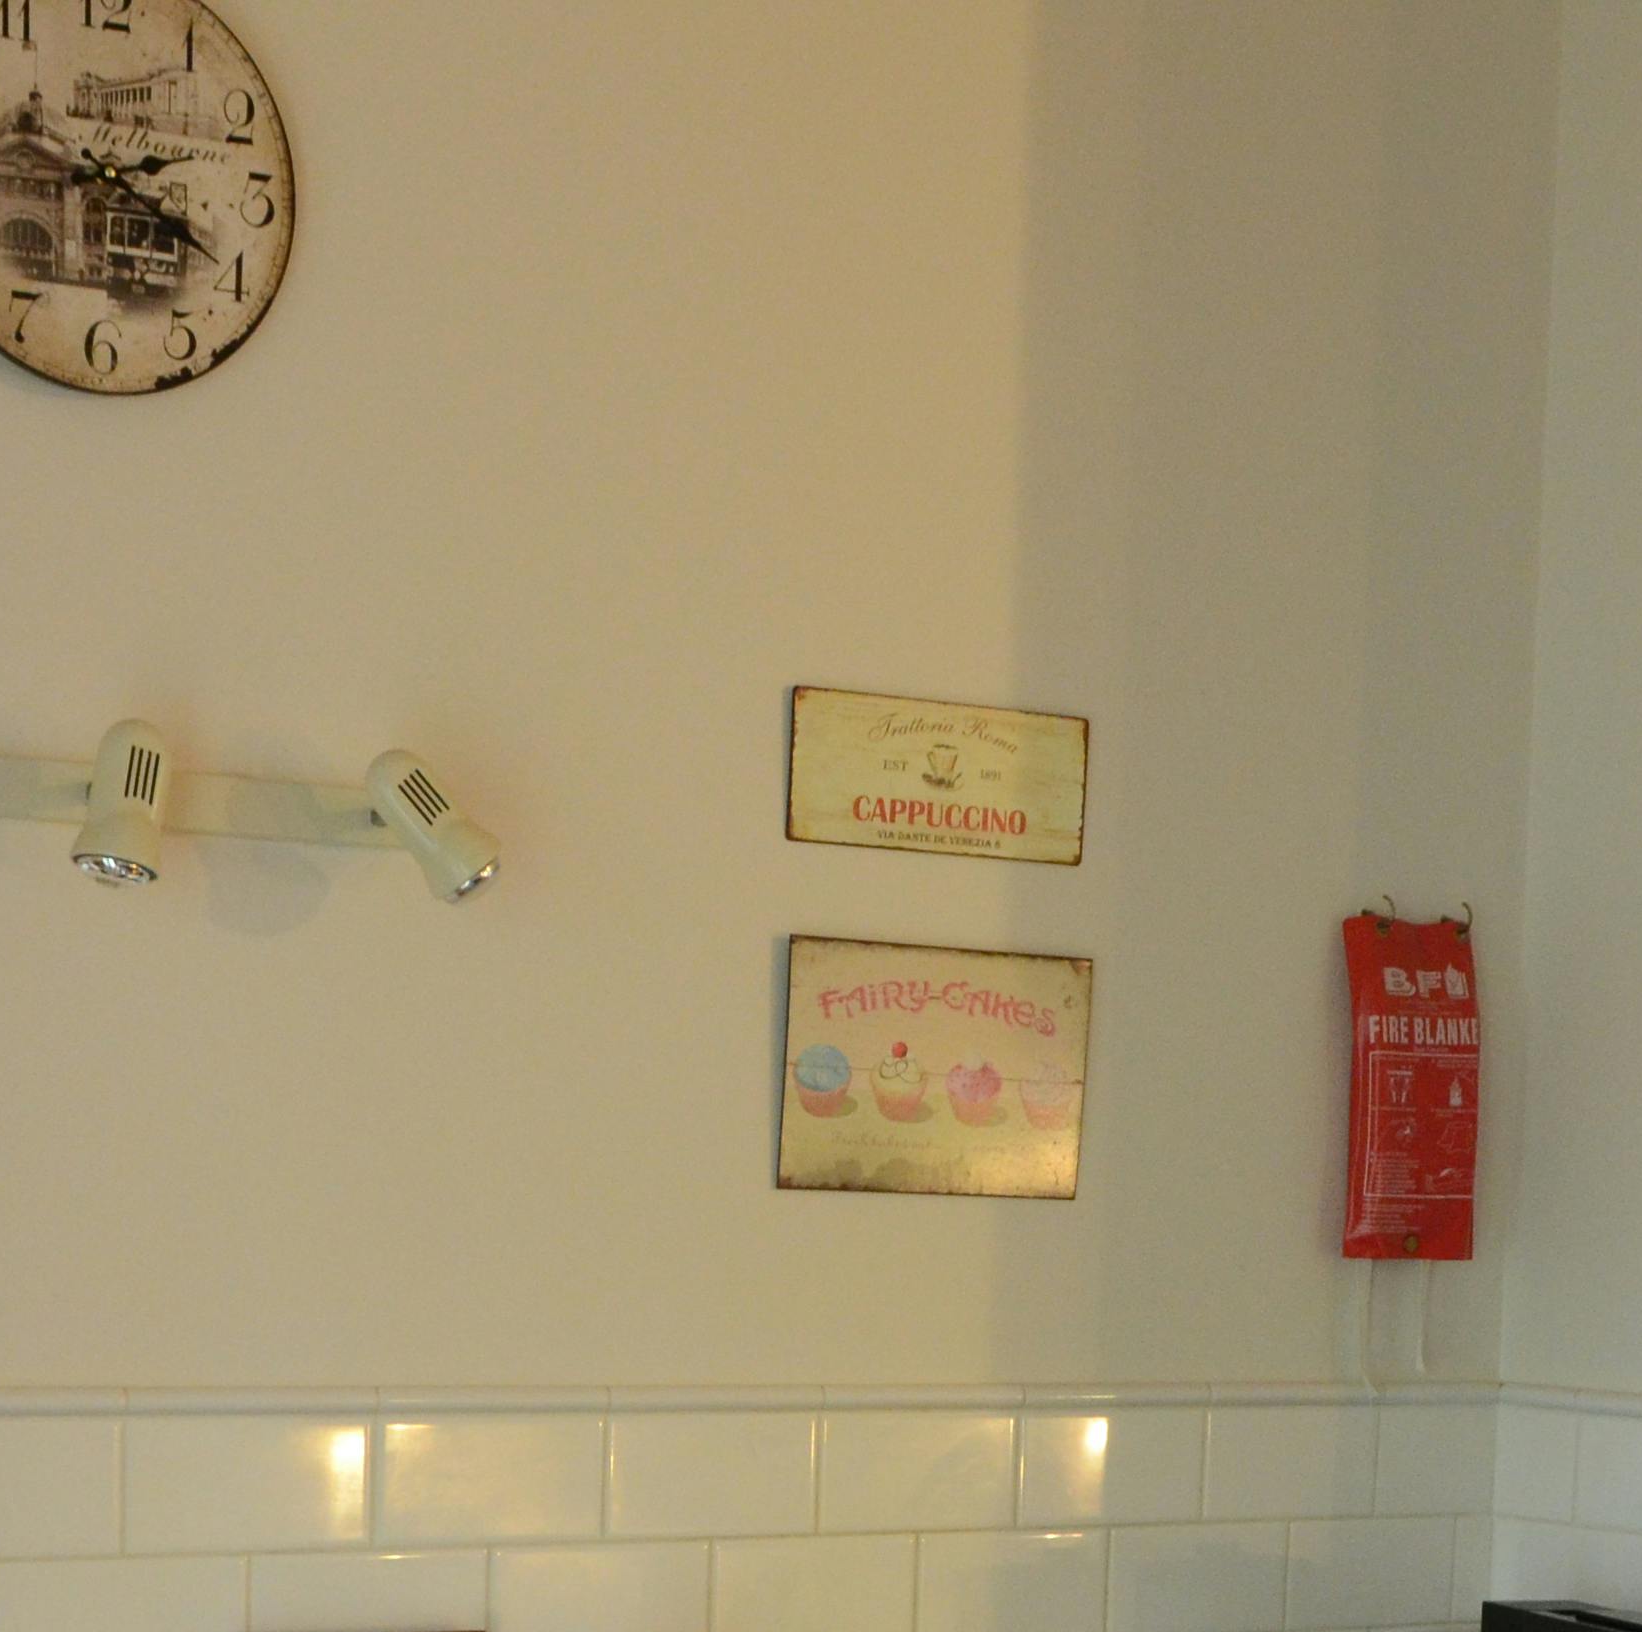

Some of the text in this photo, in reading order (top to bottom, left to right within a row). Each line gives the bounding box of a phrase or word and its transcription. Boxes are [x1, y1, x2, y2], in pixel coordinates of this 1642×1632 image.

[182, 17, 195, 73] 1
[223, 89, 256, 145] 2
[240, 172, 275, 228] 3
[213, 250, 250, 304] 4
[9, 289, 43, 344] 7
[163, 308, 197, 361] 5
[84, 320, 123, 375] 6
[868, 712, 1019, 754] Trattoria Roma
[883, 759, 909, 772] EST
[852, 794, 1028, 836] CAPPUCCINO
[1368, 1014, 1479, 1046] FIRE BLANKE
